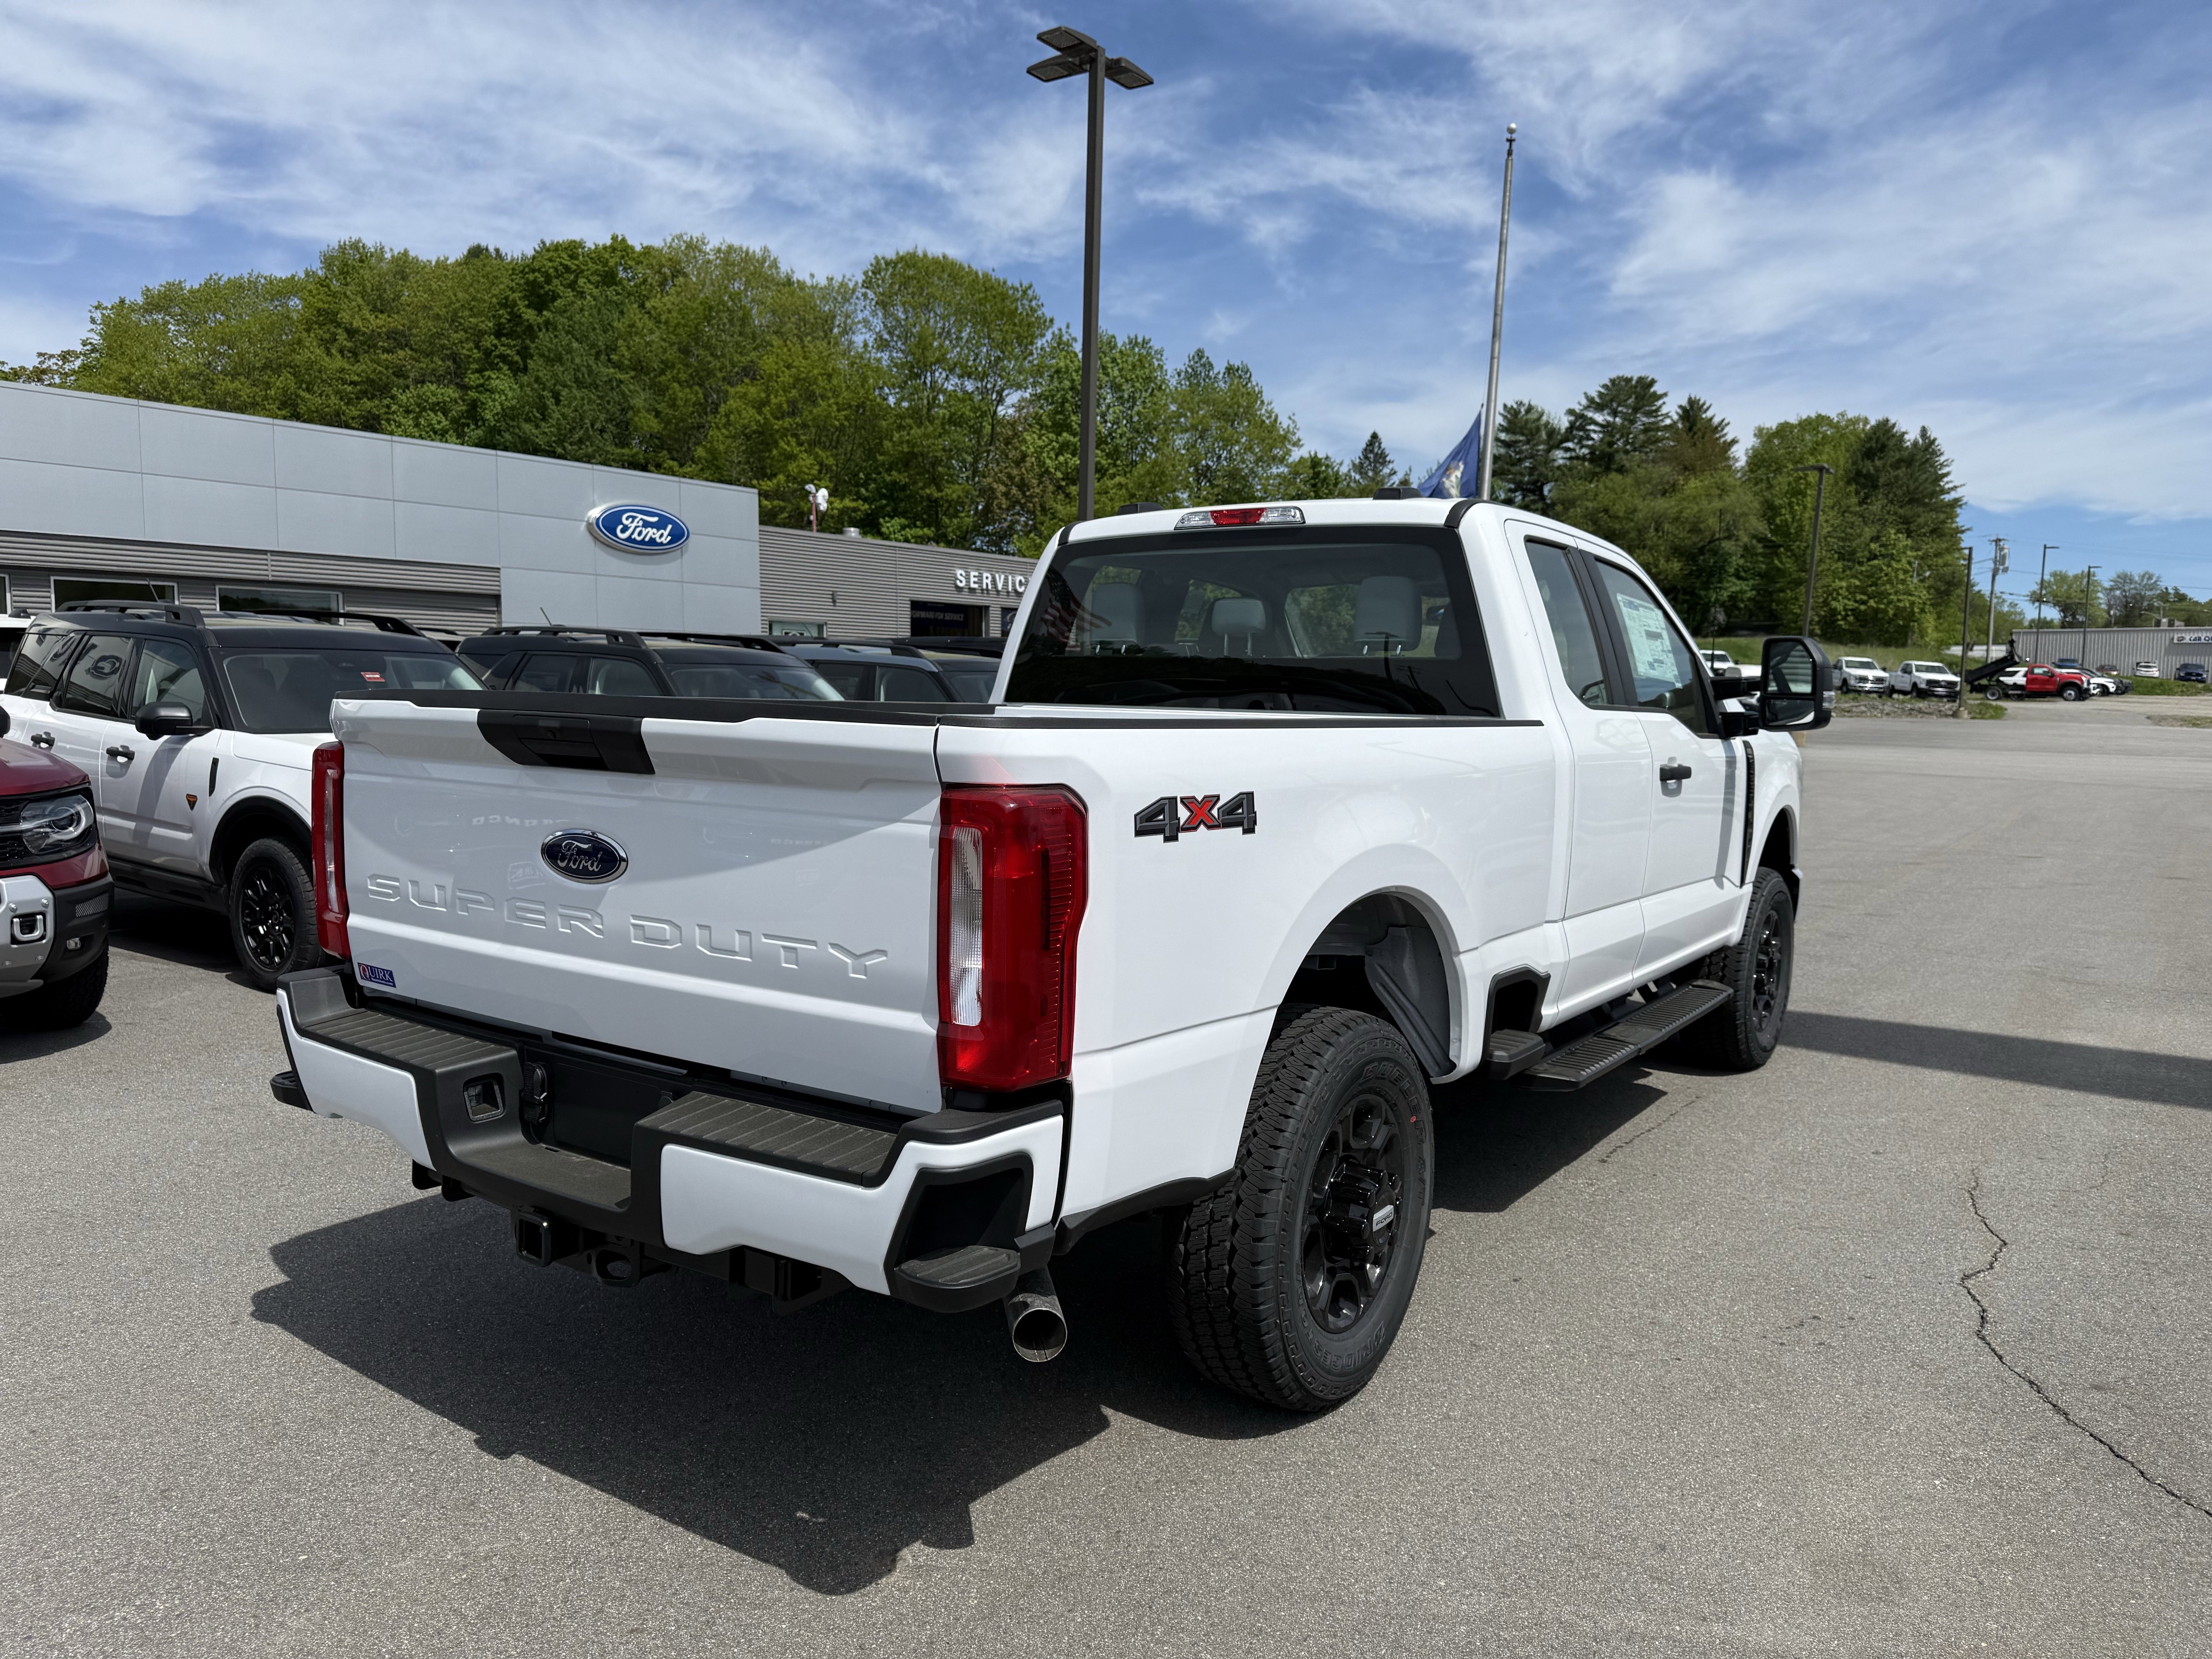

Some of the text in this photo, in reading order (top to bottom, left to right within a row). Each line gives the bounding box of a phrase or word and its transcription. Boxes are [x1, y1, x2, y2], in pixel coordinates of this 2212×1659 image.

[617, 512, 672, 544] Ford
[955, 569, 1030, 592] SERVIC
[944, 611, 964, 621] SERVICE
[557, 840, 603, 871] Ford
[367, 874, 888, 979] SUPER DUTY
[360, 965, 393, 982] QUIRK
[1376, 1212, 1393, 1226] FORD
